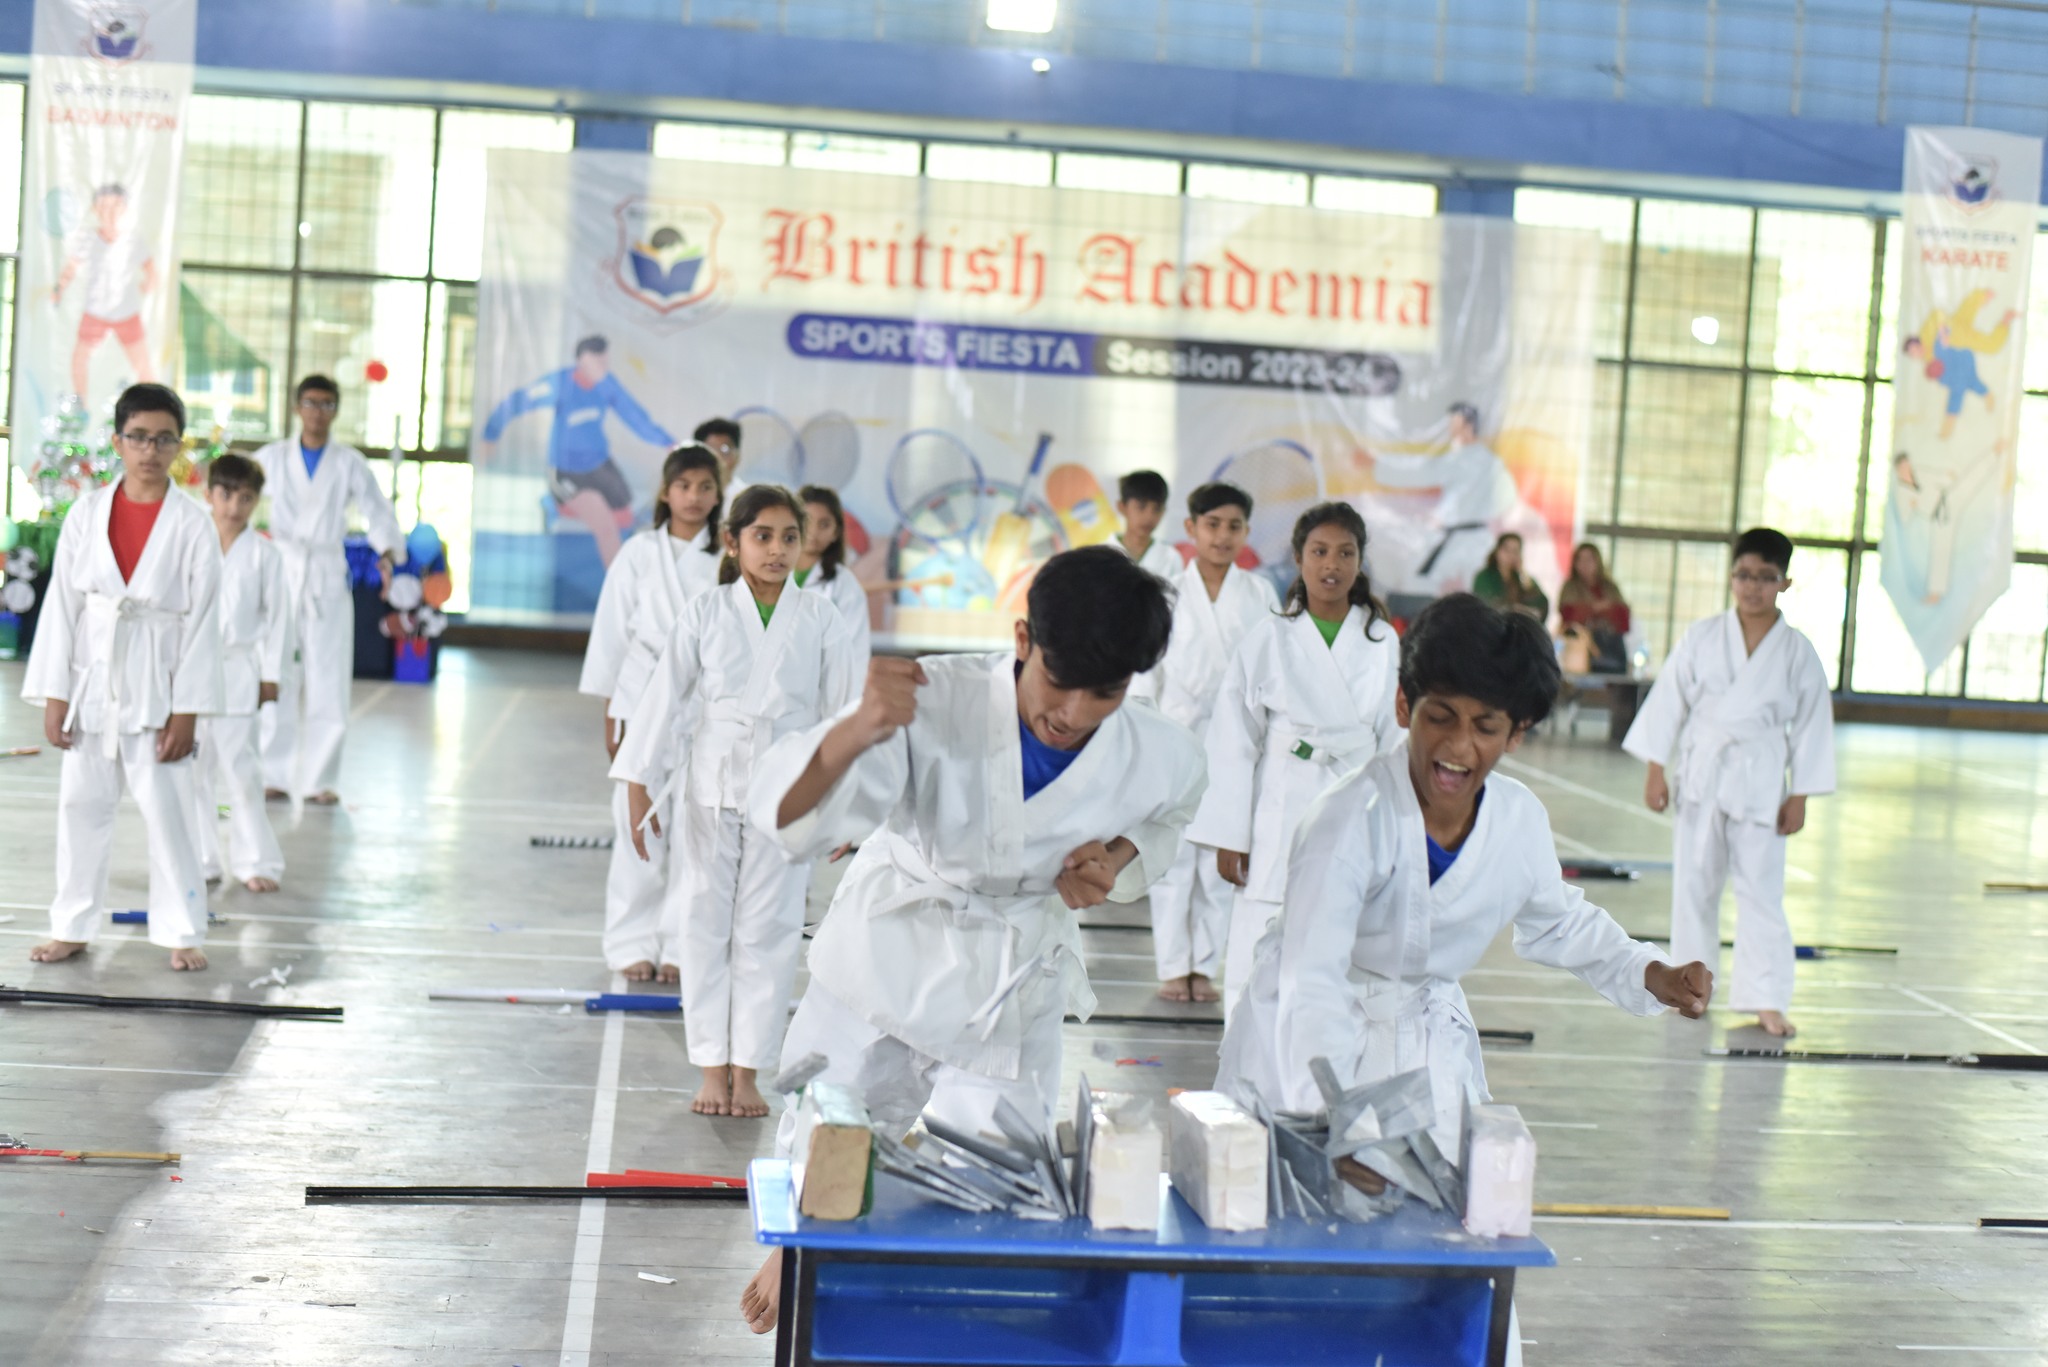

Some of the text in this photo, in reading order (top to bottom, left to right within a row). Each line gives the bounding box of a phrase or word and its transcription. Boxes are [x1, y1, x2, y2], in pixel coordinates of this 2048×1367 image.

[761, 208, 1432, 326] British Academia
[1920, 247, 2010, 272] KARATE
[801, 319, 1377, 389] SPORTS FIESTA Session 2023-24
